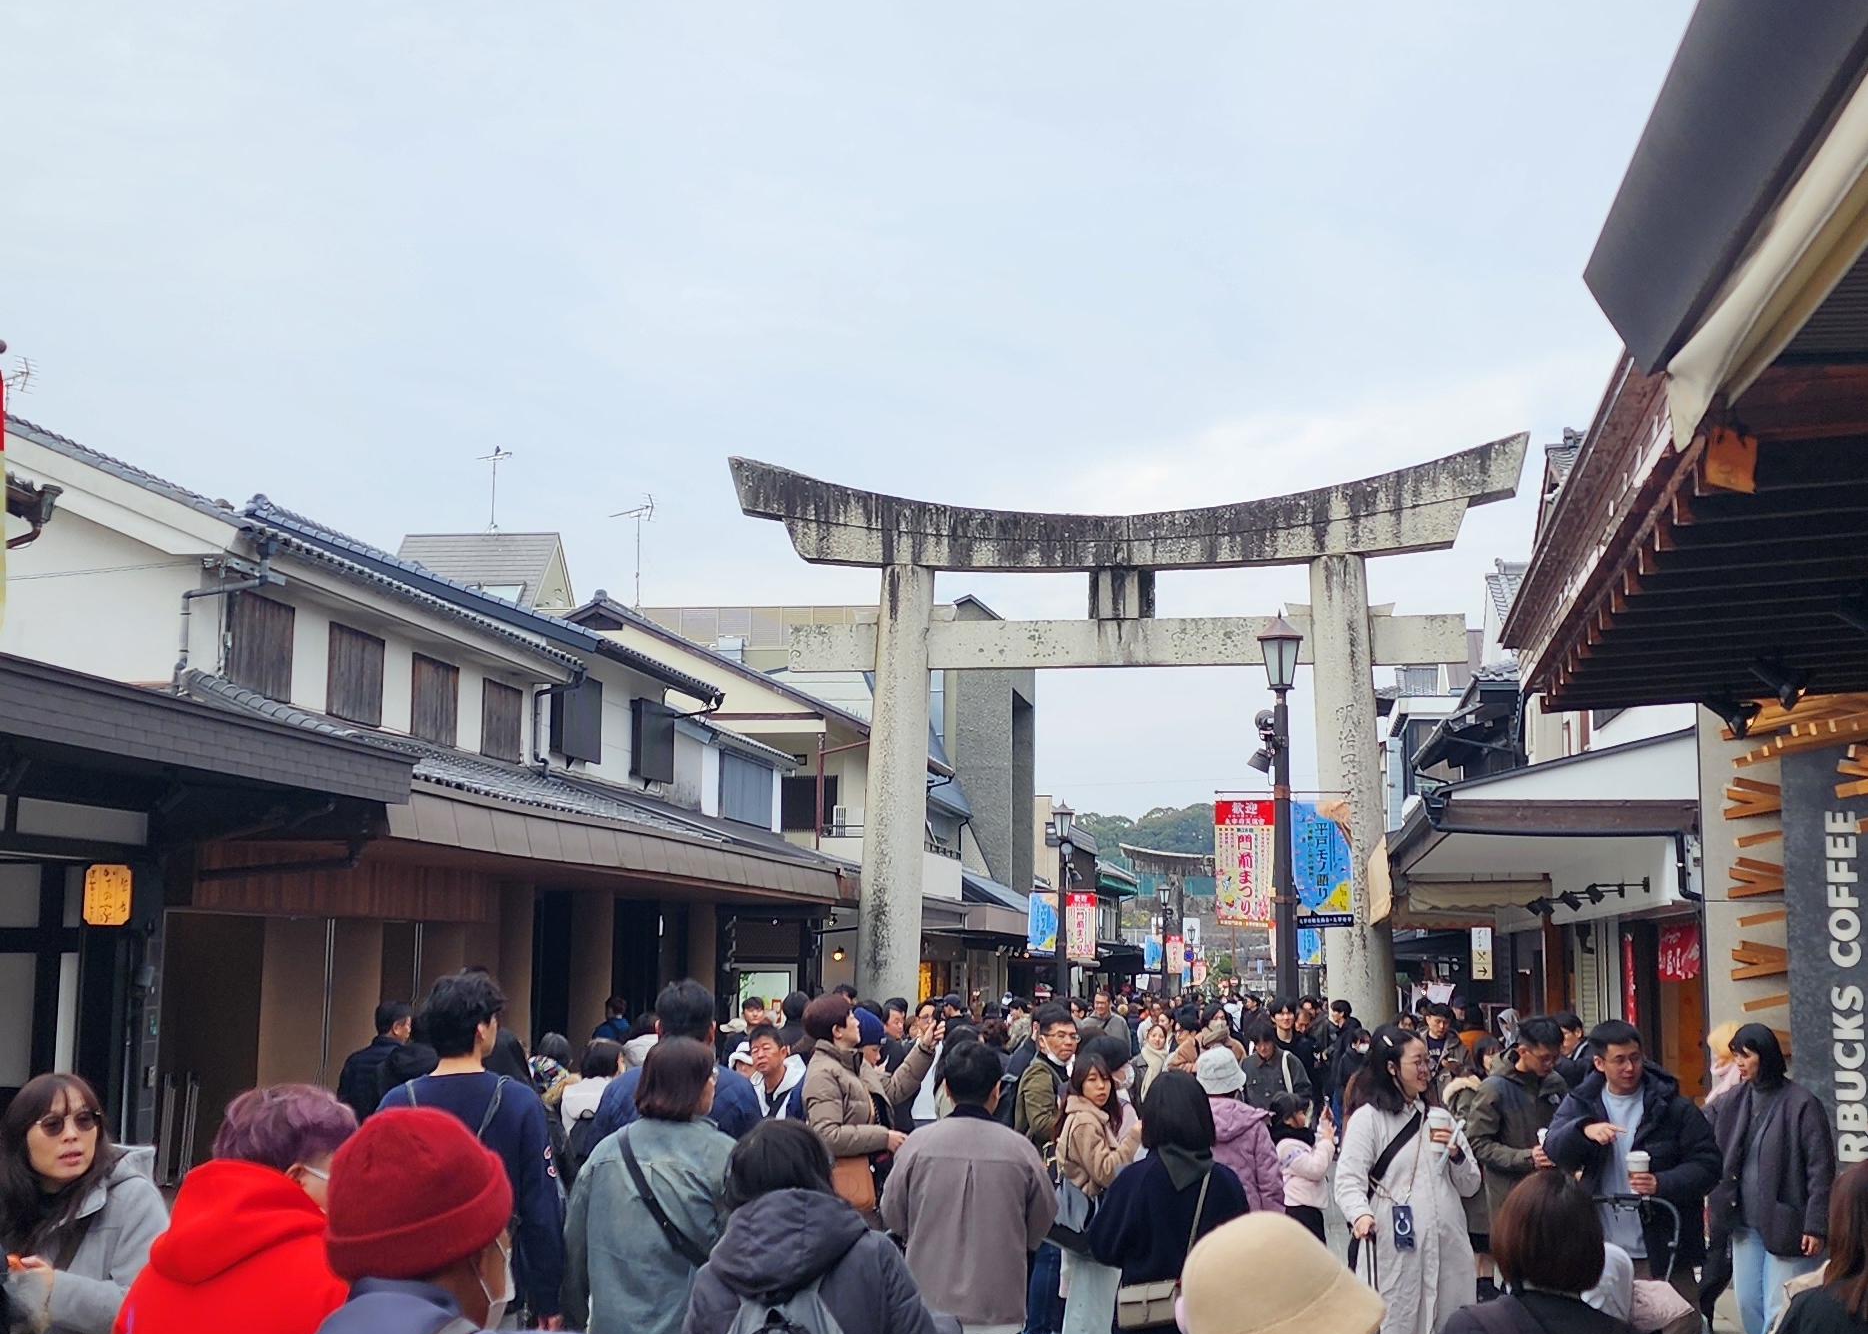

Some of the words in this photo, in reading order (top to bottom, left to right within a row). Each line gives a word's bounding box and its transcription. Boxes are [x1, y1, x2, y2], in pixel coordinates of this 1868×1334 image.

[1237, 833, 1253, 916] 門前まつり
[1314, 822, 1329, 900] 平戸モノ語り
[1825, 810, 1863, 968] COFFEE
